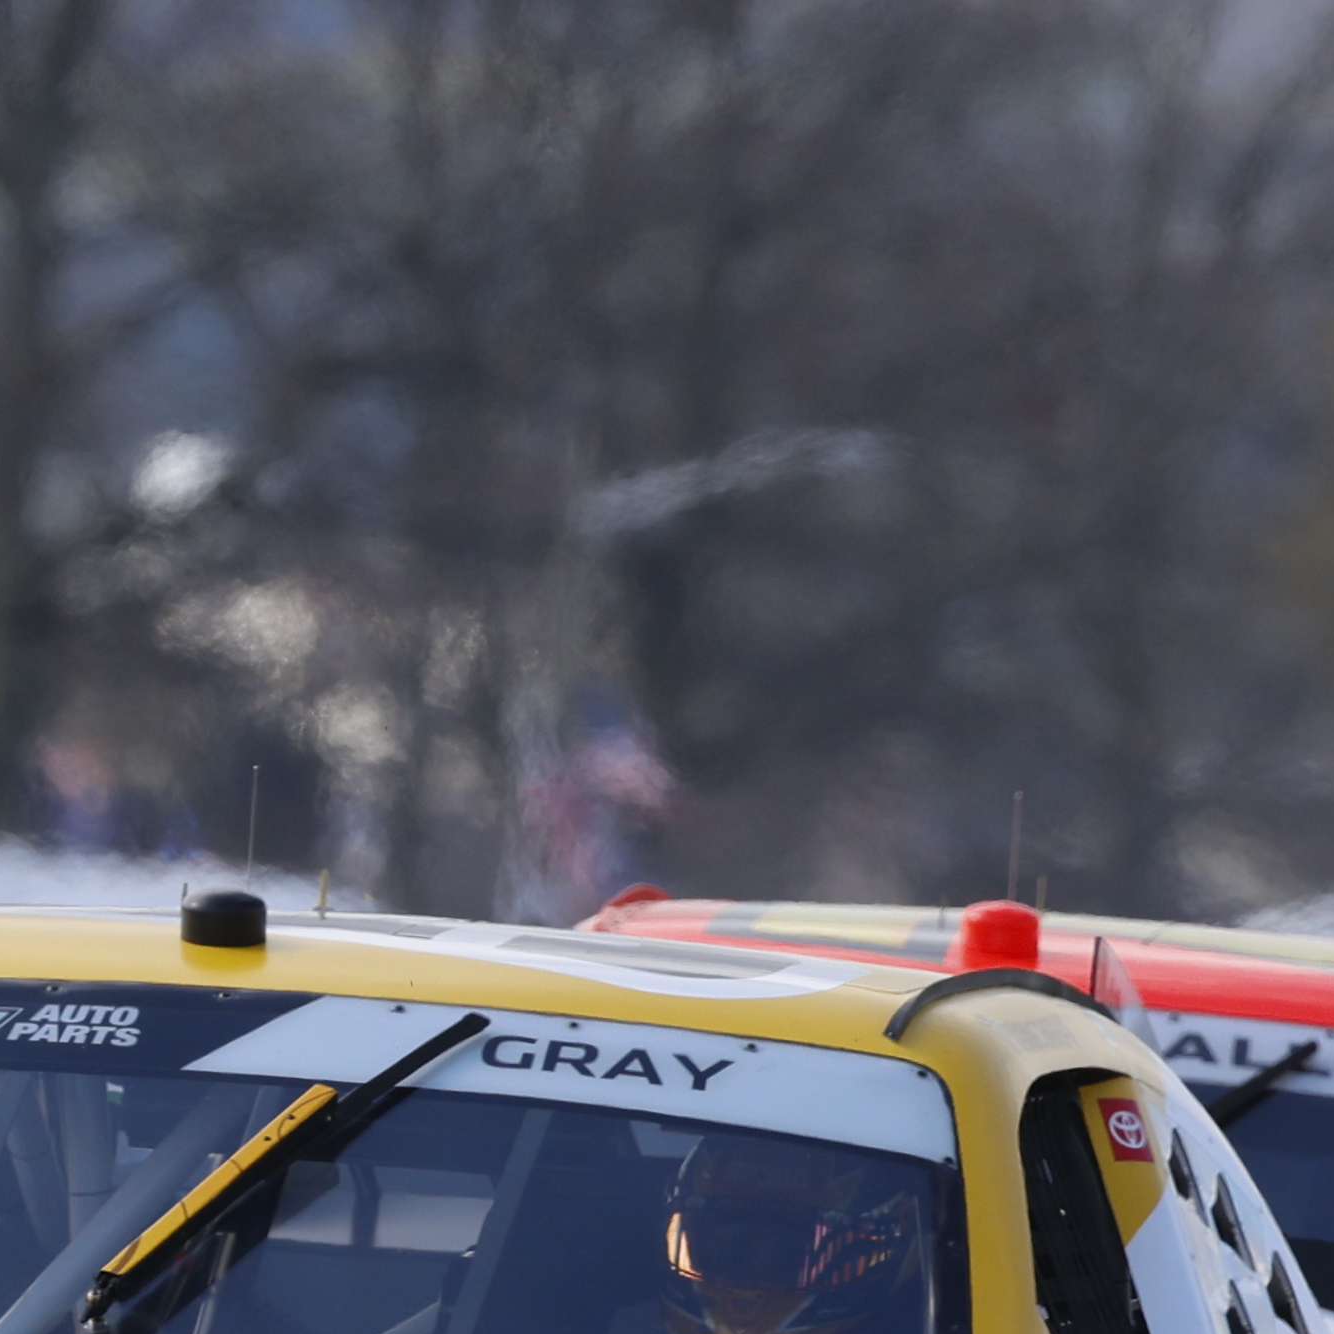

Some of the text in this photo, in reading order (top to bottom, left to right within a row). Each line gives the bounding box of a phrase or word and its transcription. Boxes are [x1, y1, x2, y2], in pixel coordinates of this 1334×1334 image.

[30, 1003, 140, 1026] AUTO
[6, 1022, 142, 1048] PARTS
[480, 1034, 735, 1092] GRAY
